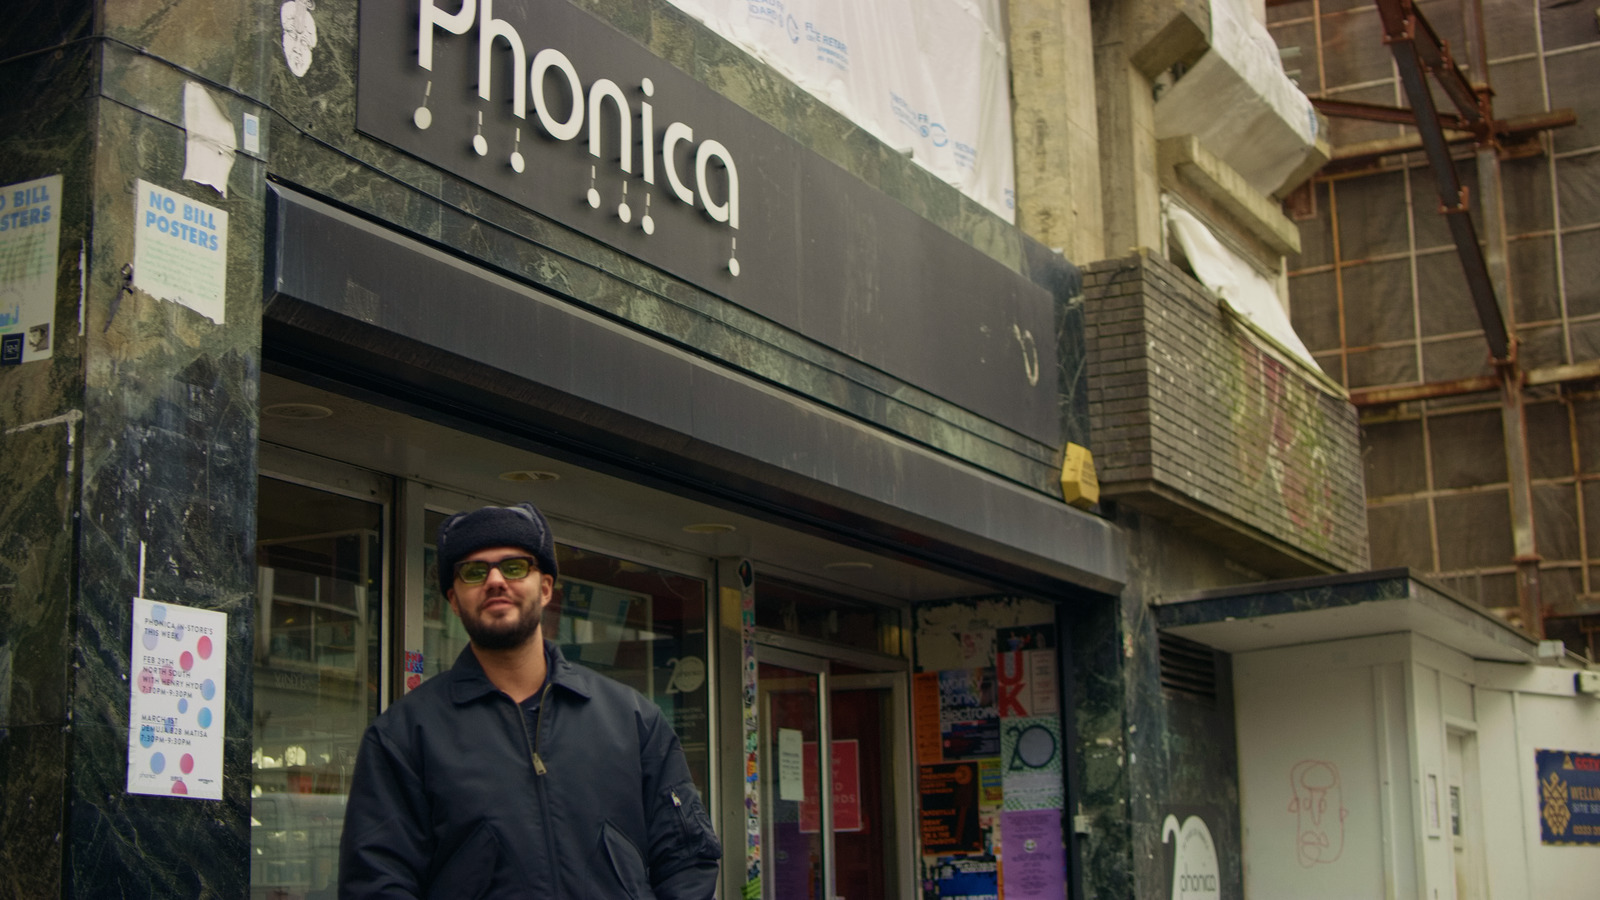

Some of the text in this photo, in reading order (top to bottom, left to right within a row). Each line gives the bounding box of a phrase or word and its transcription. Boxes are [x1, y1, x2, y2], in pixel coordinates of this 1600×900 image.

[13, 185, 49, 208] BILL
[149, 190, 217, 230] NO BILL
[145, 210, 219, 251] POSTERS
[144, 617, 176, 629] PHONICA
[144, 627, 179, 640] THIS WEEK
[143, 655, 155, 664] FEB
[142, 666, 191, 678] NORTH SOUTH
[141, 714, 166, 723] MARCH
[184, 729, 208, 738] MATISA
